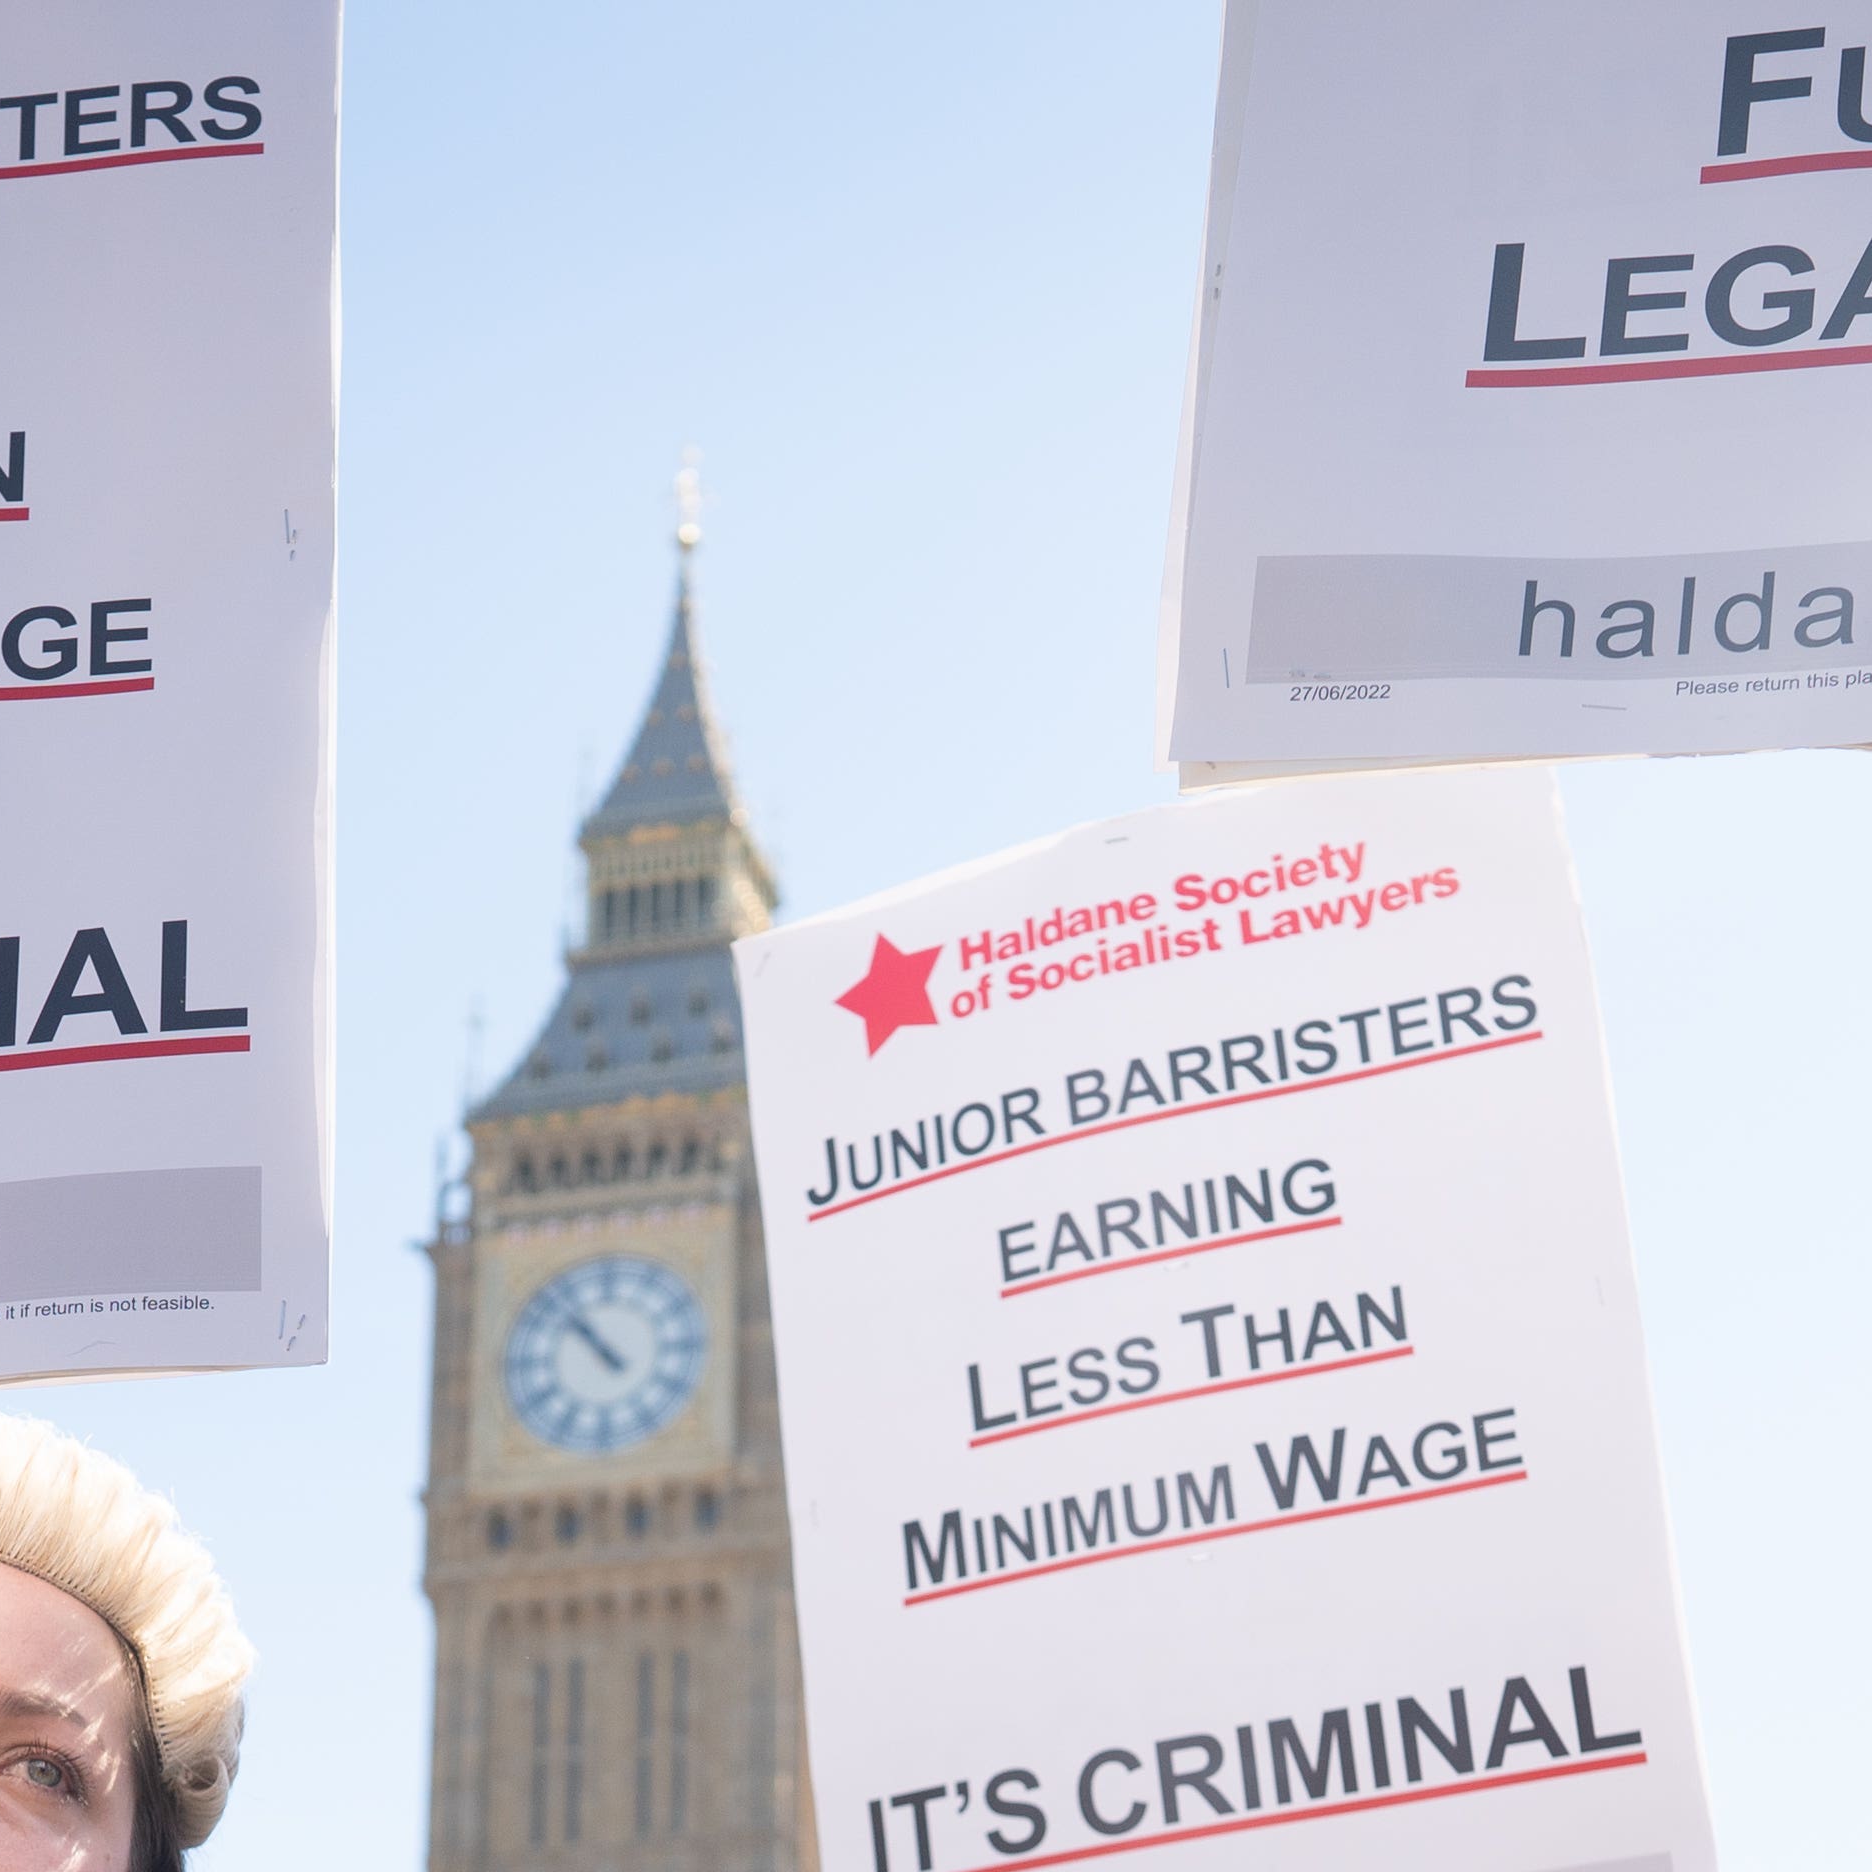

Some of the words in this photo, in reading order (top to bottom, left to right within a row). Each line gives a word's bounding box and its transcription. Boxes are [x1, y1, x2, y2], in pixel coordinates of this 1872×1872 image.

[1289, 683, 1392, 702] 27/06/2022
[1676, 680, 1739, 696] Please
[1745, 676, 1800, 693] return
[1807, 673, 1839, 689] this
[951, 975, 990, 1018] of
[1004, 915, 1221, 1000] Socialist
[1236, 861, 1458, 944] Lawyers
[960, 894, 1161, 975] Haldane
[1174, 844, 1372, 916] Society
[807, 1088, 1045, 1206] JUNIOR
[1066, 975, 1536, 1125] BARRISTERS
[999, 1159, 1336, 1282] EARNING
[5, 1305, 15, 1320] it
[20, 1304, 30, 1319] if
[35, 1300, 84, 1316] return
[90, 1298, 104, 1313] is
[110, 1297, 136, 1312] not
[142, 1295, 215, 1310] feasible.
[968, 1338, 1159, 1431] LESS
[1181, 1286, 1407, 1378] THAN
[903, 1465, 1235, 1590] MINIMUM
[1255, 1408, 1523, 1510] WAGE
[1078, 1666, 1642, 1835] CRIMINAL
